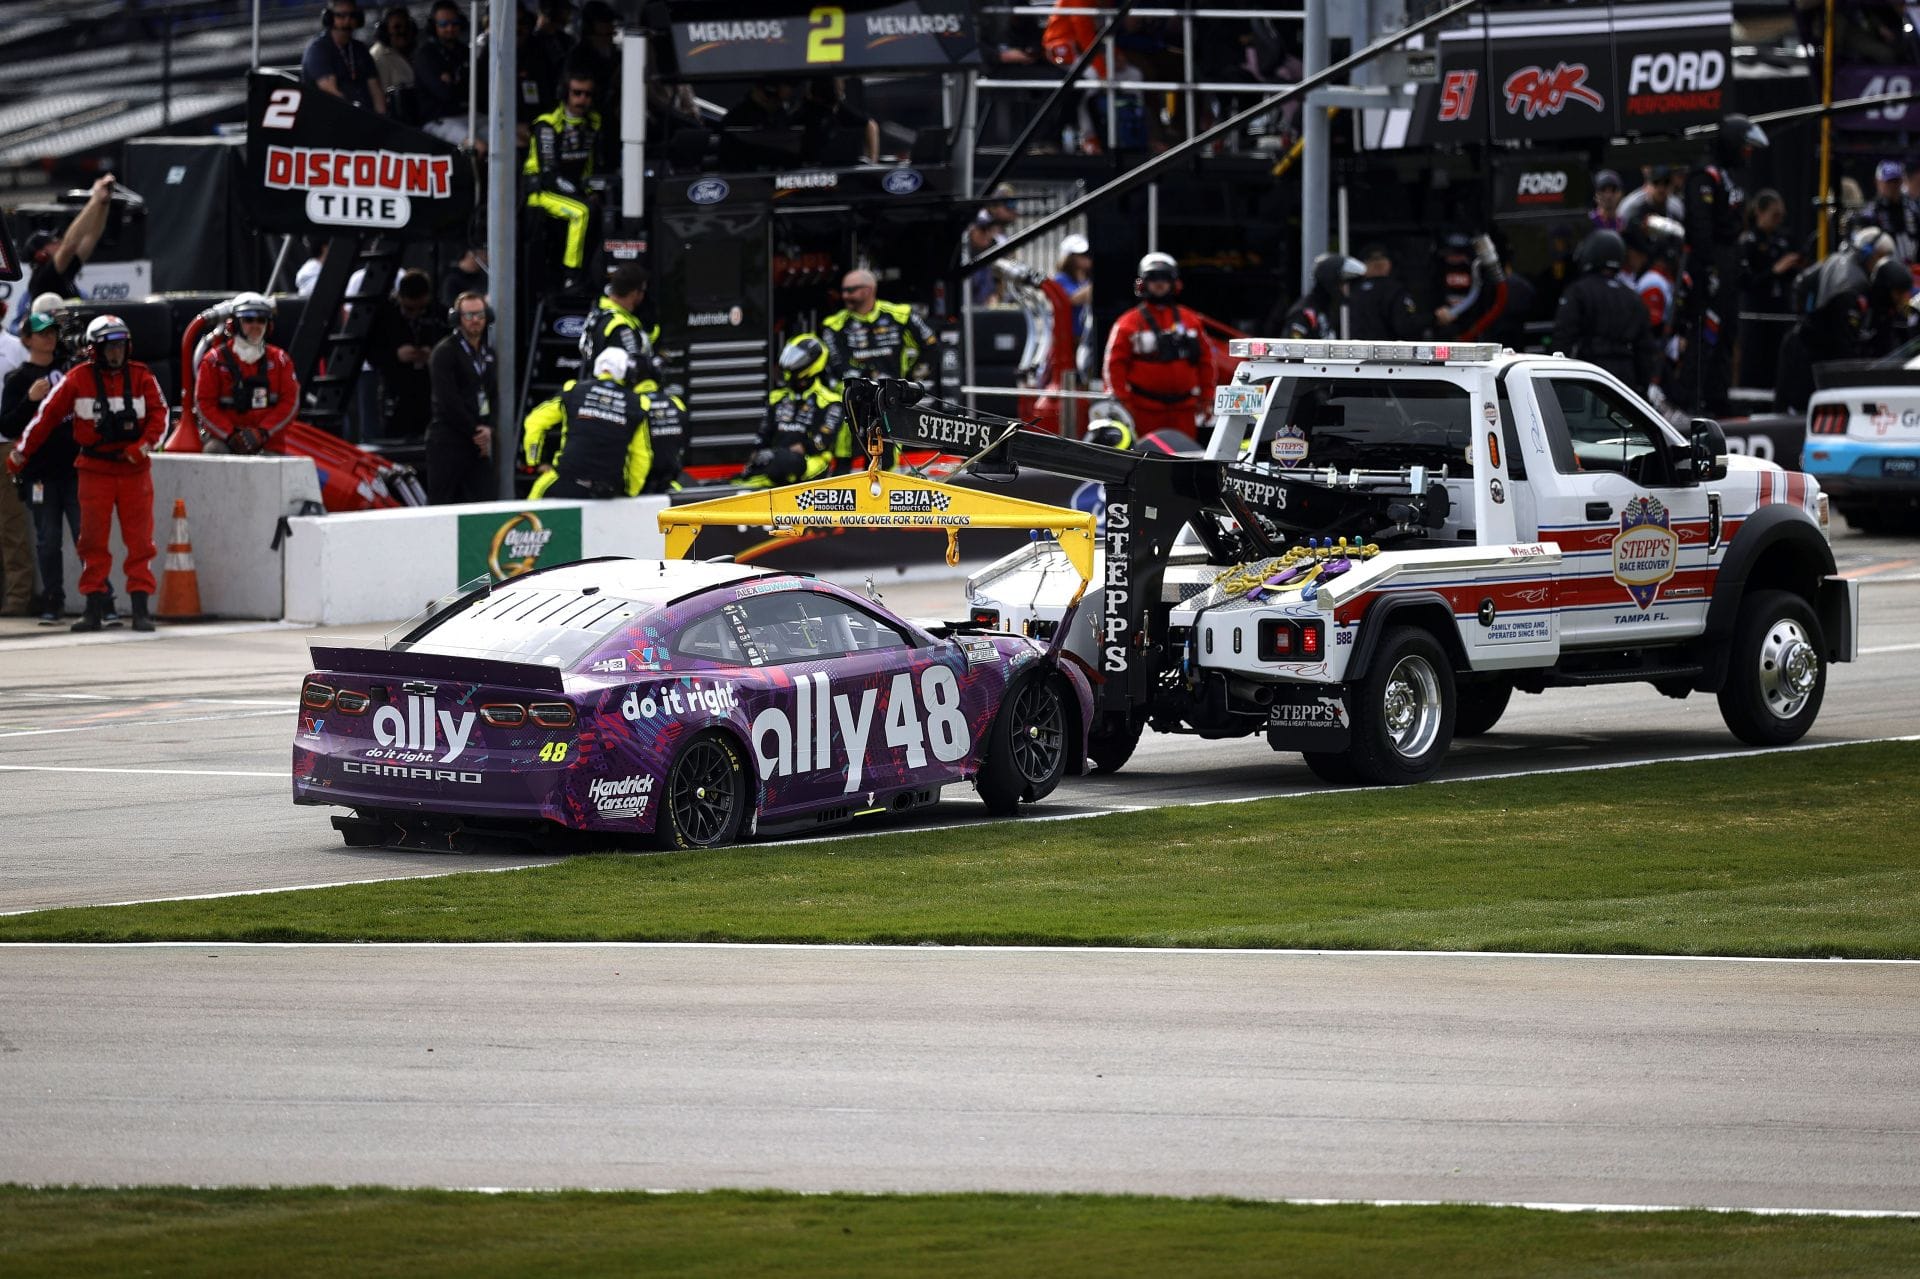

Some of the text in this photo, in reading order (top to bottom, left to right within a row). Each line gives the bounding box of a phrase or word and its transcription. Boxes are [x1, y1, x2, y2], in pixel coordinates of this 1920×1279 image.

[687, 6, 961, 63] MENARDS 2 MENARDS
[1629, 49, 1725, 95] FORD
[1438, 70, 1478, 121] 51
[262, 89, 301, 129] 2
[267, 148, 450, 196] DISCOUNT
[775, 173, 838, 189] MENARDS
[1518, 172, 1567, 194] FORD
[319, 196, 396, 219] TIRE
[918, 414, 990, 449] STEPP'S
[775, 516, 800, 525] SLOW
[802, 516, 832, 525] DOWN
[839, 515, 866, 525] MOVE
[867, 515, 891, 525] OVER
[893, 515, 911, 525] FOR
[912, 515, 936, 525] TOW
[936, 515, 970, 525] TRUCKS
[509, 545, 544, 558] STATE
[1620, 538, 1670, 559] STEPP'S
[1619, 560, 1670, 572] RACE RECOVERY
[1491, 621, 1545, 631] FAMILY OWNED AND
[1614, 612, 1669, 624] TAMPA FL.
[1487, 631, 1516, 640] OPERATED
[622, 680, 739, 721] do it right.
[1270, 704, 1334, 720] STEPP'S
[373, 695, 476, 763] ally
[752, 665, 971, 793] ally 48
[366, 748, 434, 763] do it right.
[539, 742, 568, 762] 48
[343, 761, 482, 784] CAMARO
[588, 774, 655, 802] Hendrick
[597, 795, 649, 811] Cars.com
